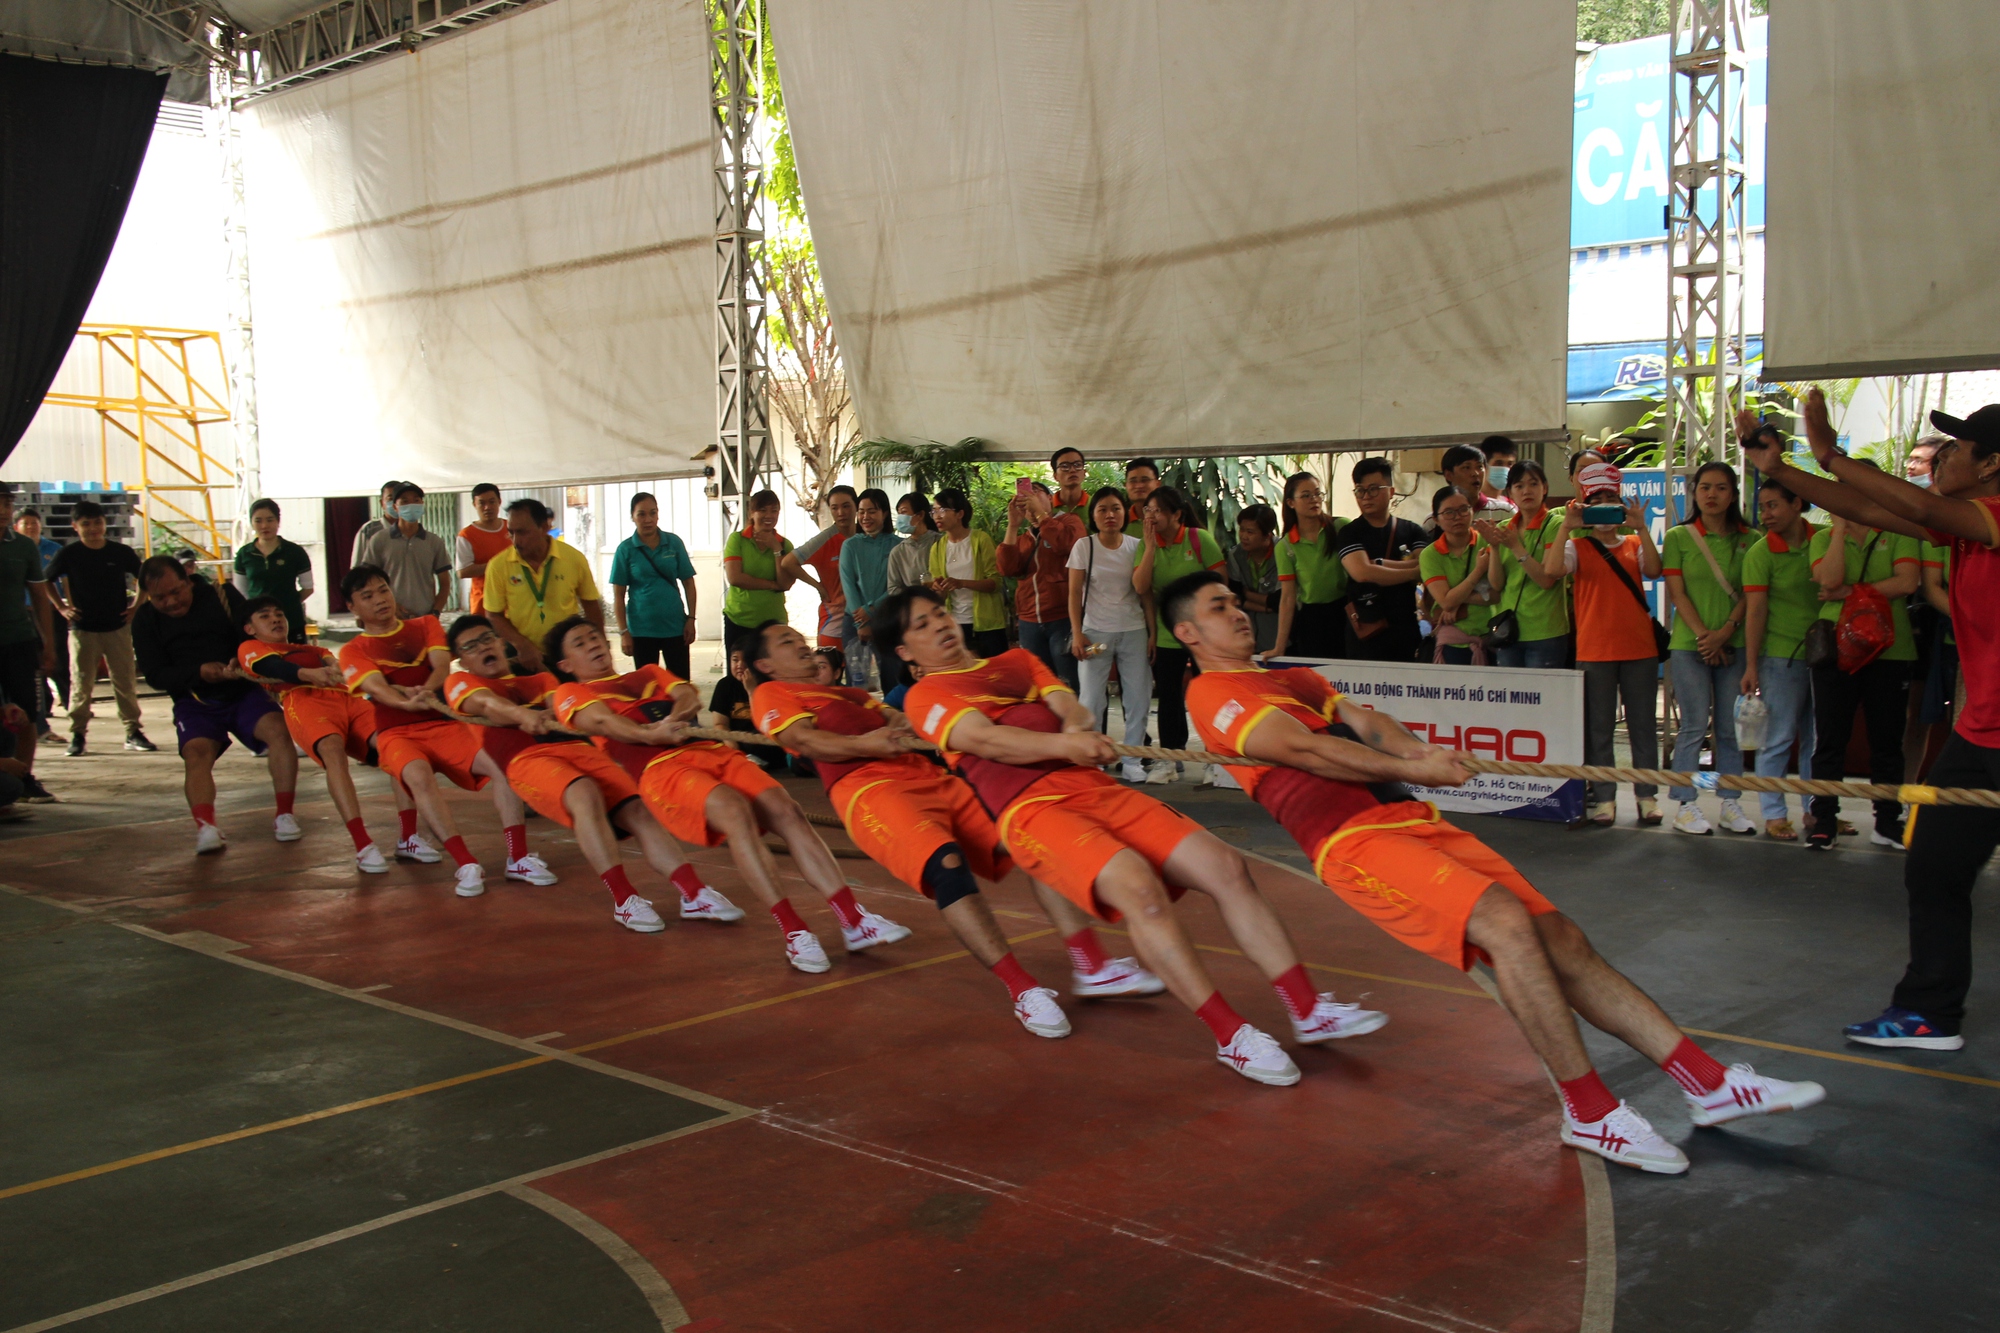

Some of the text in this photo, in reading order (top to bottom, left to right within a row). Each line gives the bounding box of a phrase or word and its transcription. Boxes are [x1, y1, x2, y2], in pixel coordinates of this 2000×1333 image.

[1620, 482, 1638, 497] NG
[1639, 479, 1661, 497] VĂN
[1663, 478, 1686, 497] ÓA
[1353, 682, 1371, 695] LAO
[1374, 681, 1403, 699] ĐỘNG
[1406, 683, 1441, 700] THÀNH
[1444, 683, 1466, 701] PHỐ
[1488, 687, 1507, 703] CHÍ
[1510, 690, 1541, 705] MINH
[1472, 778, 1488, 788] Tp.
[1507, 781, 1526, 791] Chí
[1528, 782, 1554, 793] Minh
